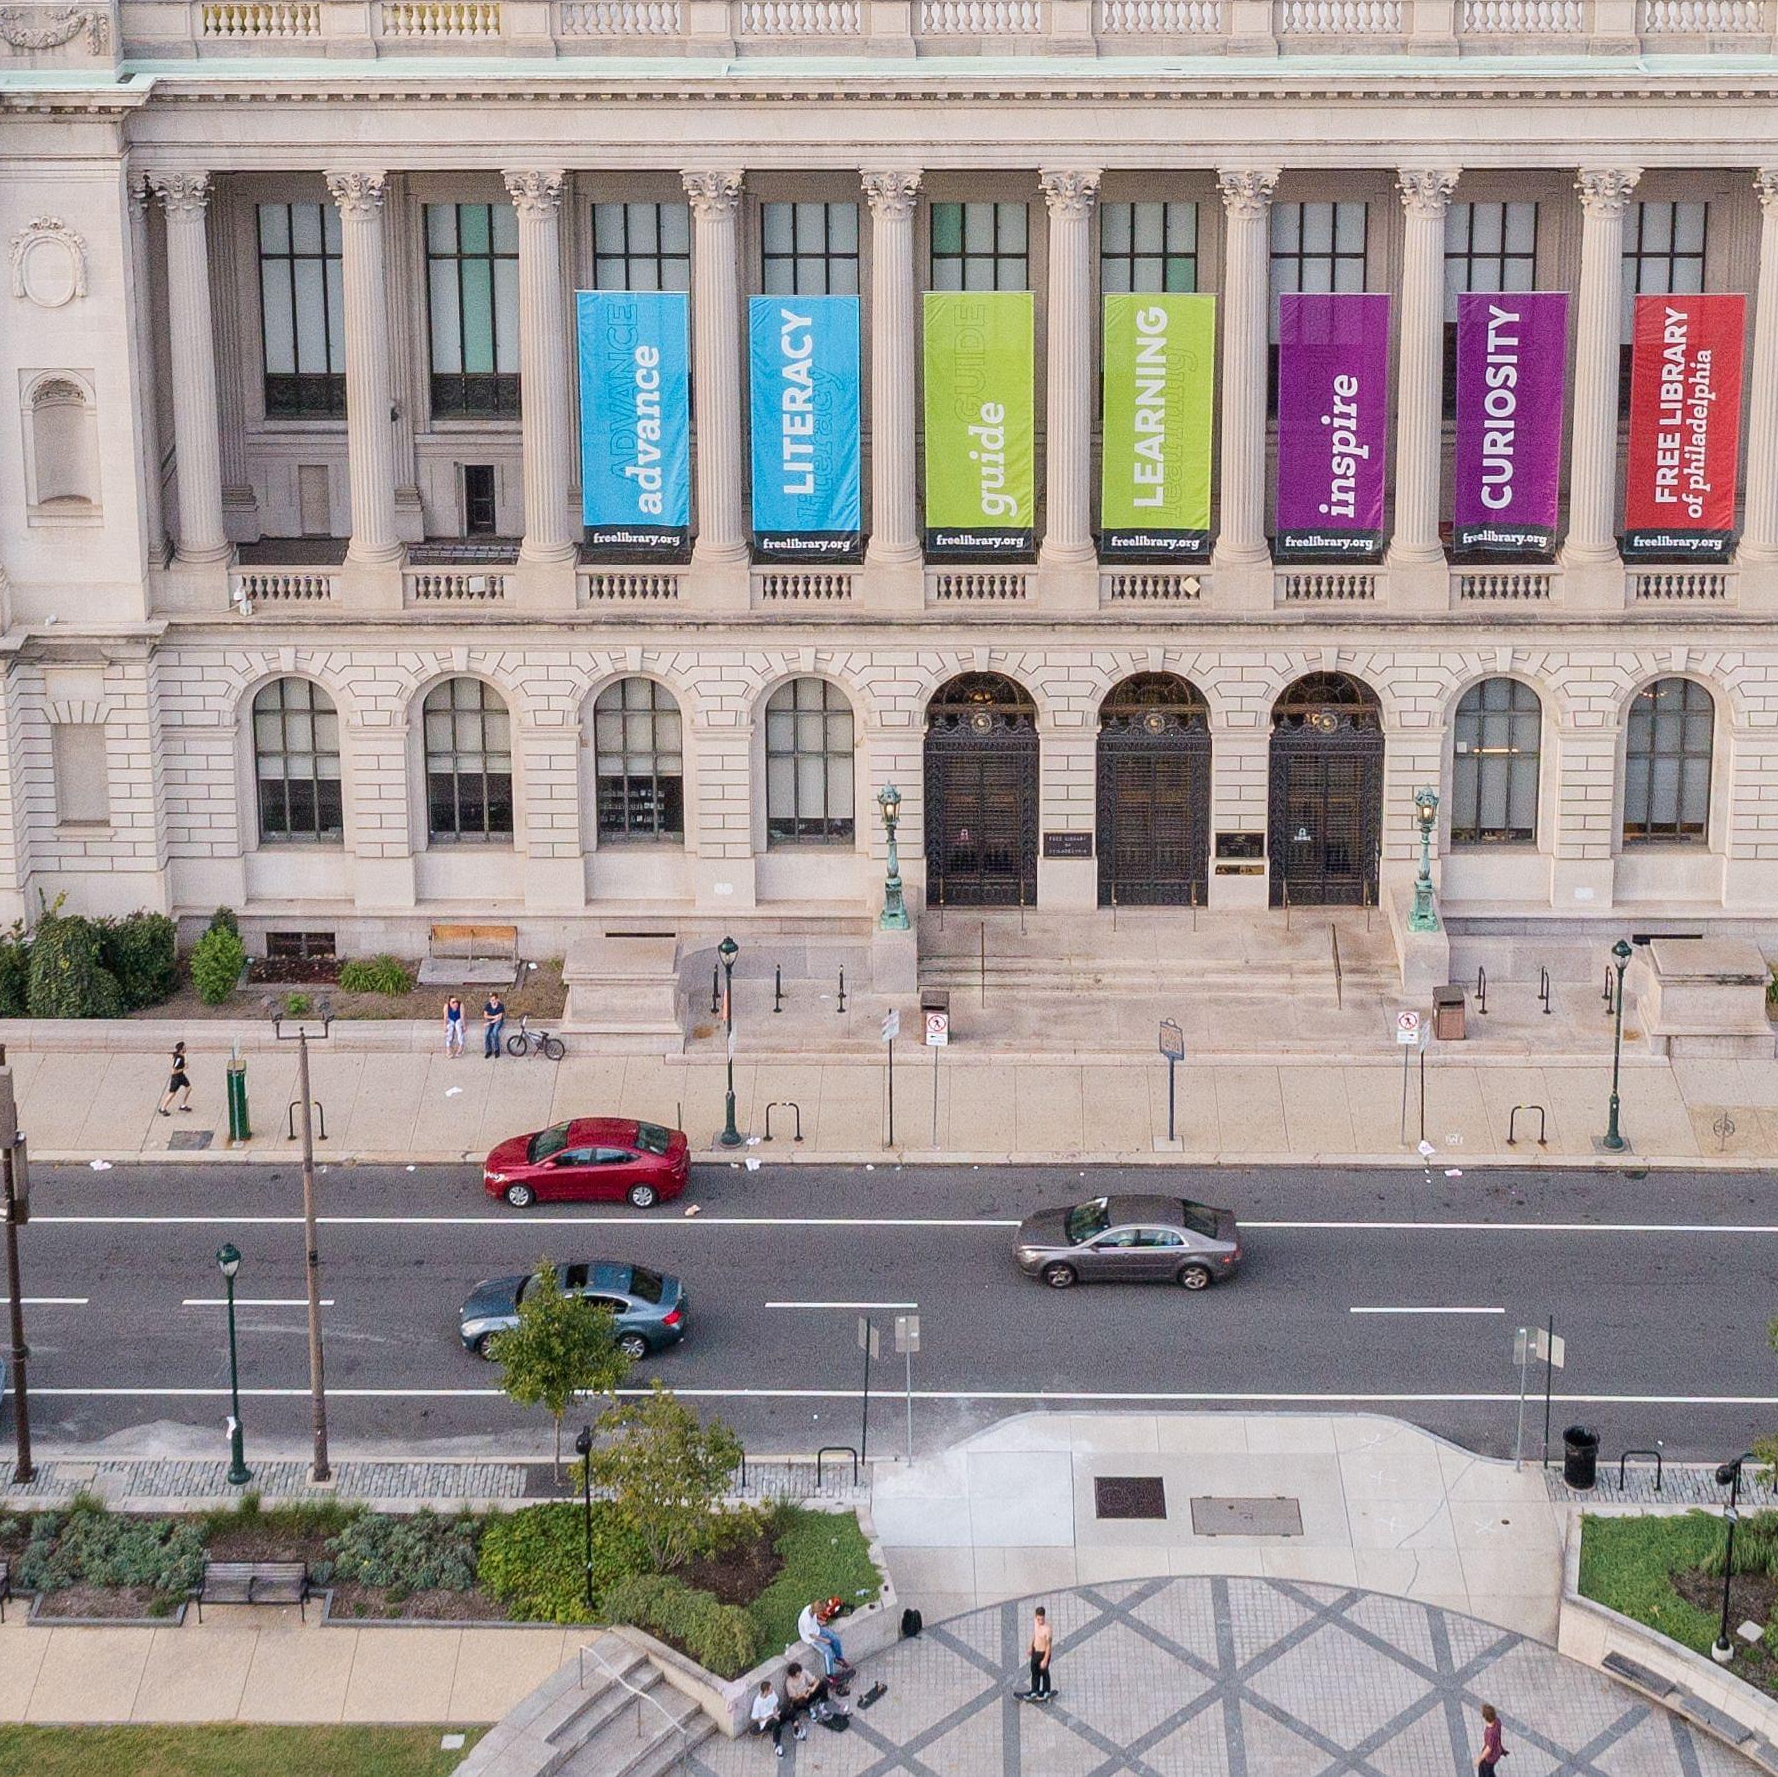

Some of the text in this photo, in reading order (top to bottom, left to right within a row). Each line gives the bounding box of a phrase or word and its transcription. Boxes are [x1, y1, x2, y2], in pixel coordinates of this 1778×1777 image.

[781, 308, 814, 495] LITERACY
[954, 303, 986, 424] GUIDE
[1133, 306, 1169, 508] LEARNING
[1480, 304, 1521, 510] CURIOSITY
[1655, 306, 1688, 504] FREE LIBRARY
[625, 345, 662, 515] advance
[968, 401, 1018, 518] guide
[1318, 374, 1370, 519] inspire
[1681, 349, 1717, 519] of philadelphia
[593, 532, 681, 546] freelibrary.org
[762, 538, 851, 552] freelibrary.org
[936, 534, 1024, 548] freelibrary.org
[1111, 535, 1200, 549] freelibrary.org
[1285, 535, 1374, 550] freelibrary.org
[1462, 531, 1548, 547] freelibrary.org
[1633, 535, 1723, 550] freelibrary.org
